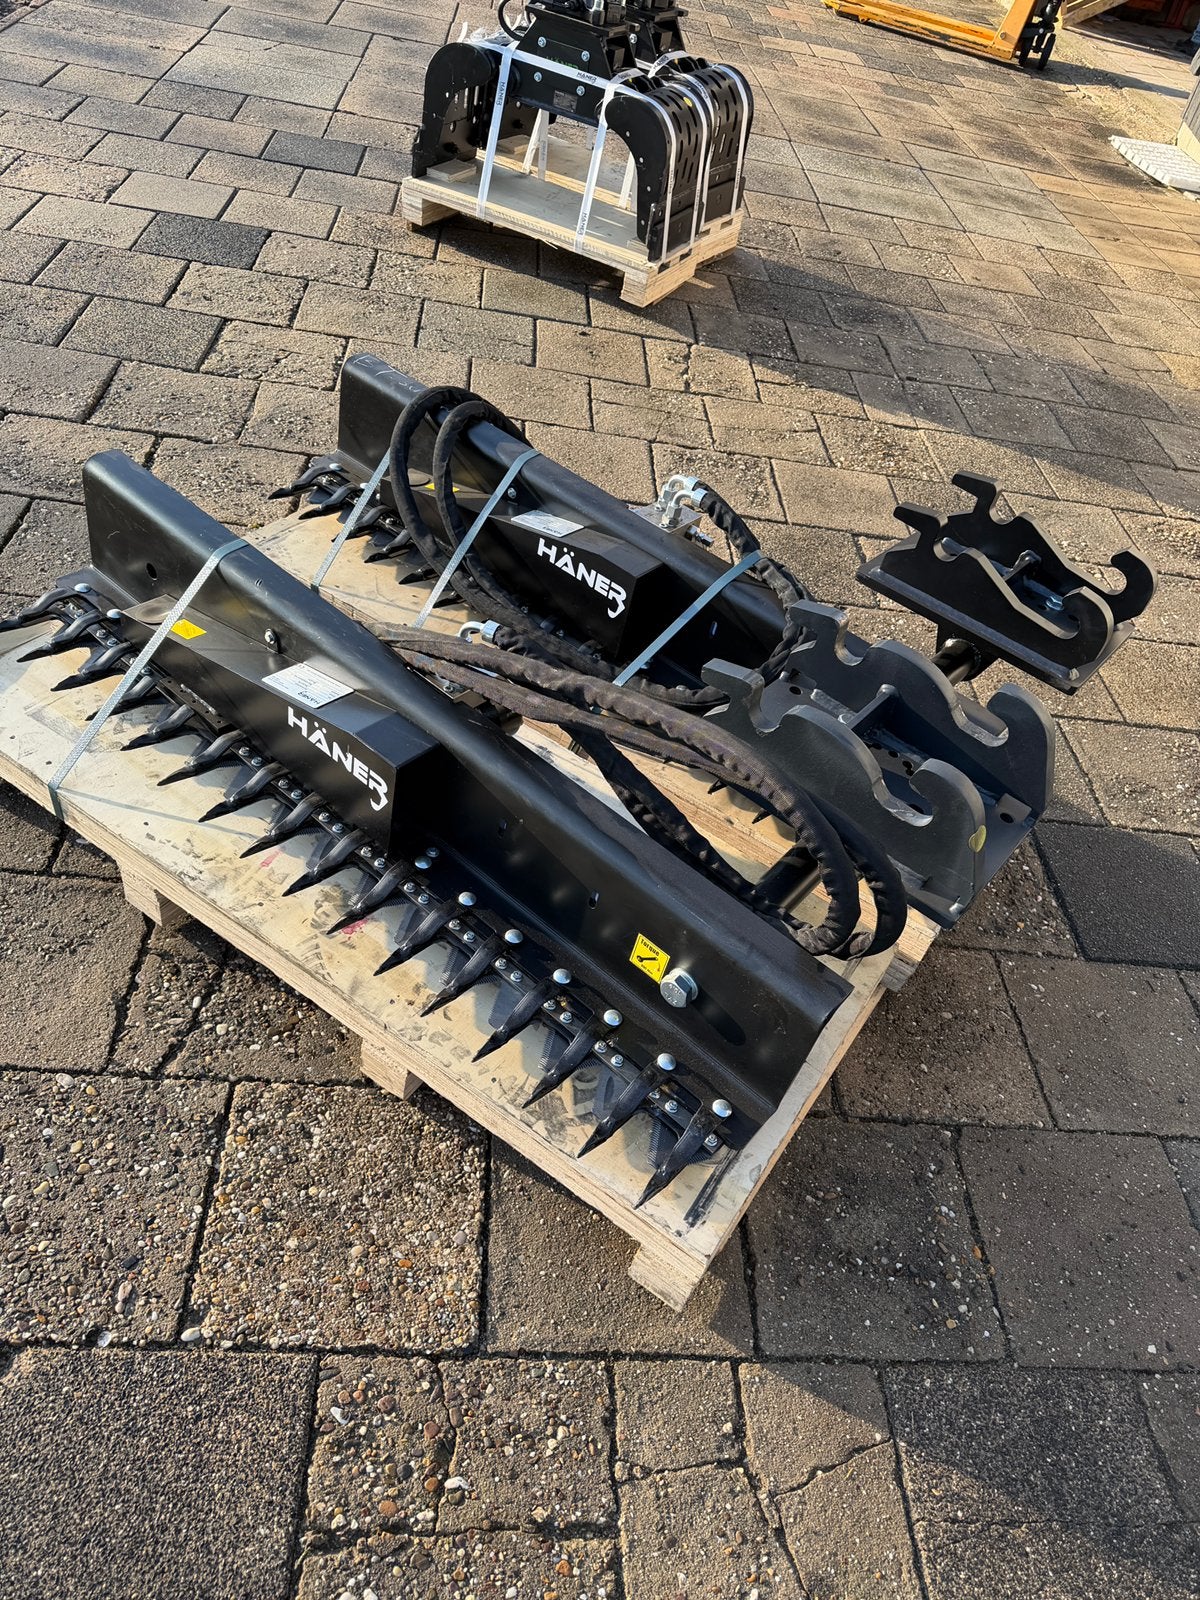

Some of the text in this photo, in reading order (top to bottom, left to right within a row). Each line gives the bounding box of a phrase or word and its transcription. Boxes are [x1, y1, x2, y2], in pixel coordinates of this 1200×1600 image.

[537, 537, 627, 619] HÄNER
[287, 706, 389, 812] HÄNER
[640, 938, 660, 957] Torque
